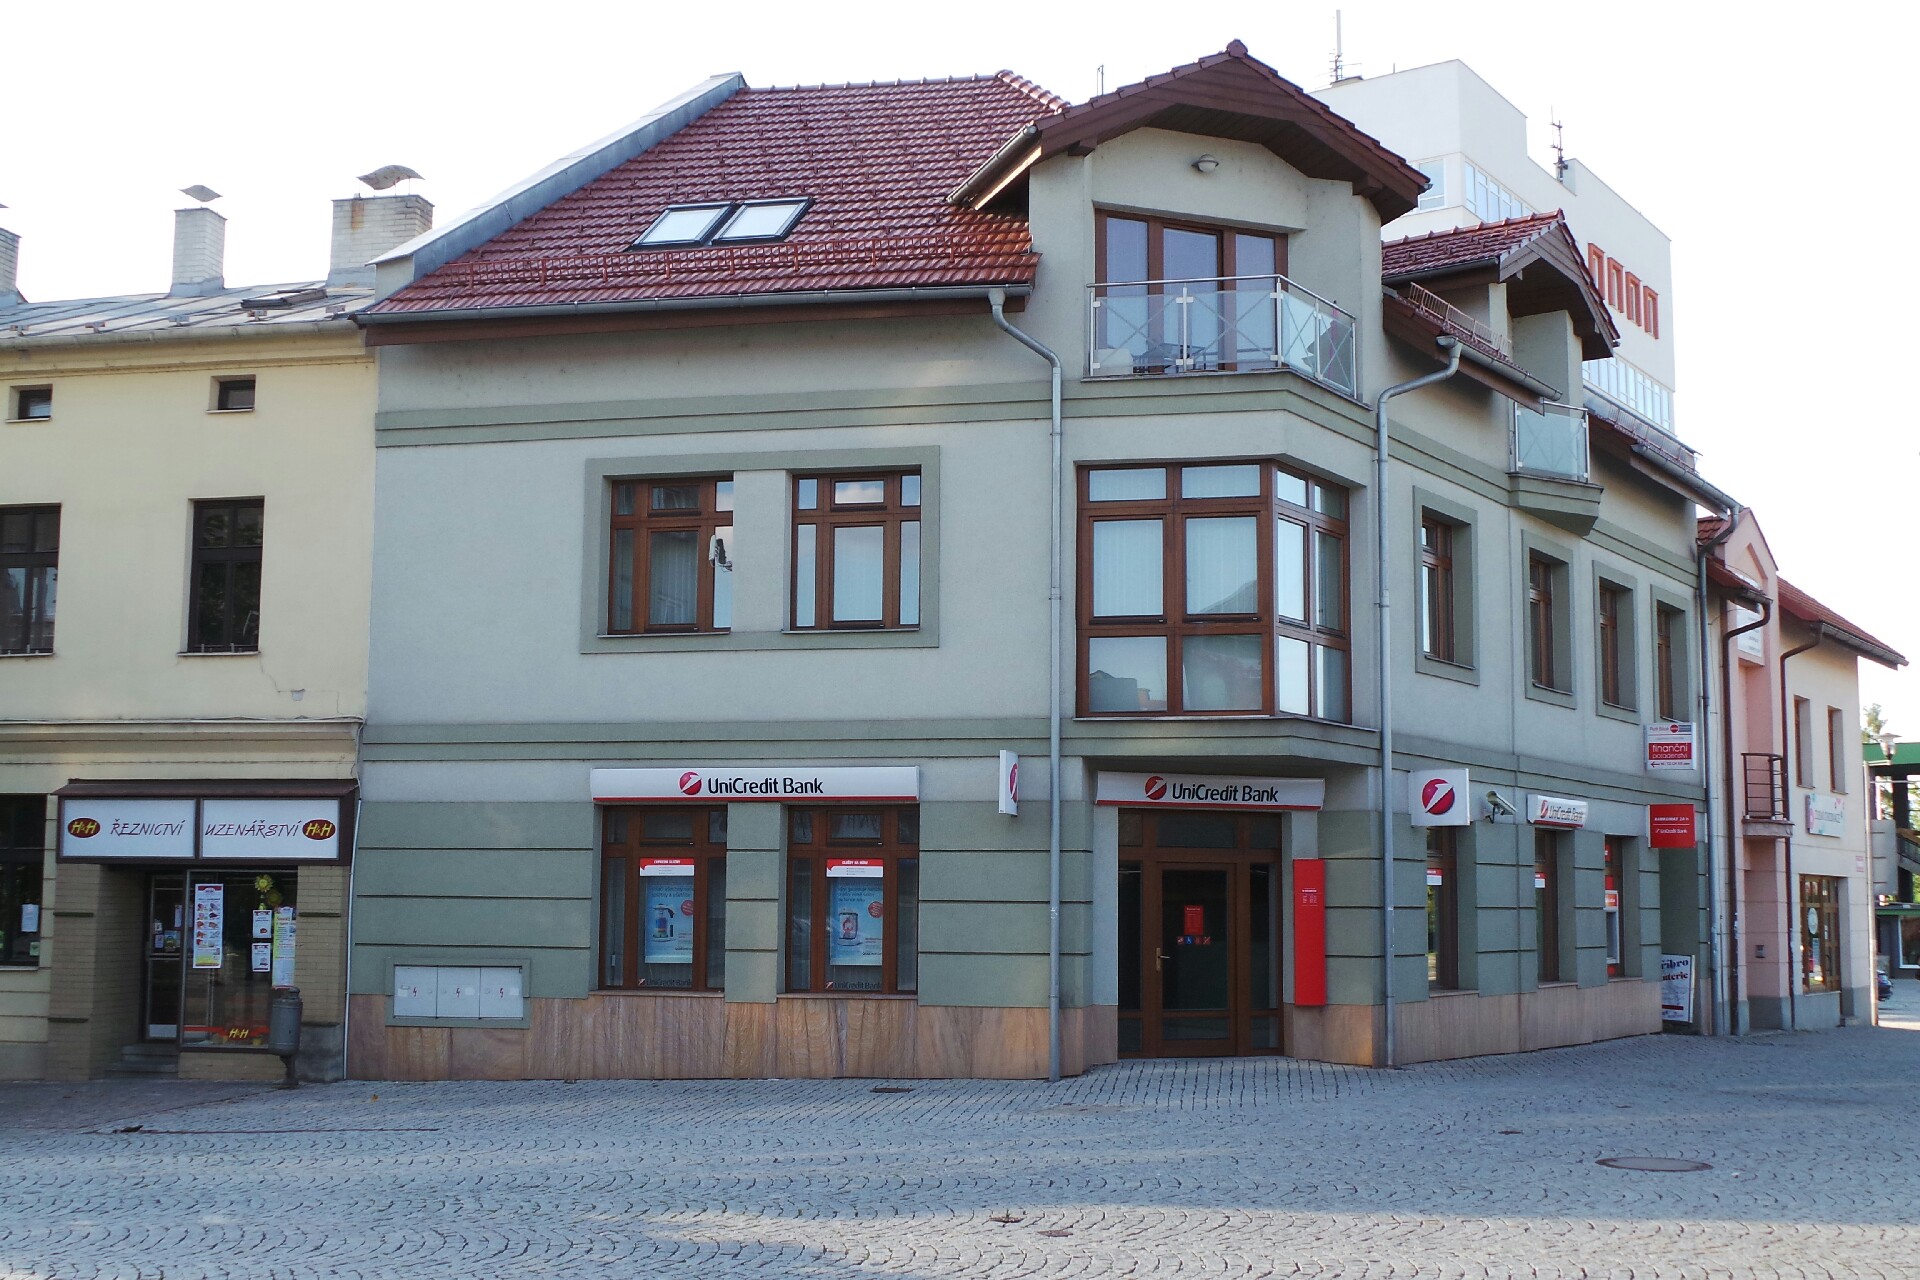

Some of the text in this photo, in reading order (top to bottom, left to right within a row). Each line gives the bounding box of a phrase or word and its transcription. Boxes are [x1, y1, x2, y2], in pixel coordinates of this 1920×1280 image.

[1652, 742, 1688, 753] finanční
[708, 777, 823, 794] UniCredit Bank
[1172, 783, 1278, 802] UniCredit Bank
[110, 818, 186, 837] ŘEZNICTVÍ
[204, 819, 334, 838] UZENÁŘSTVÍ H&H
